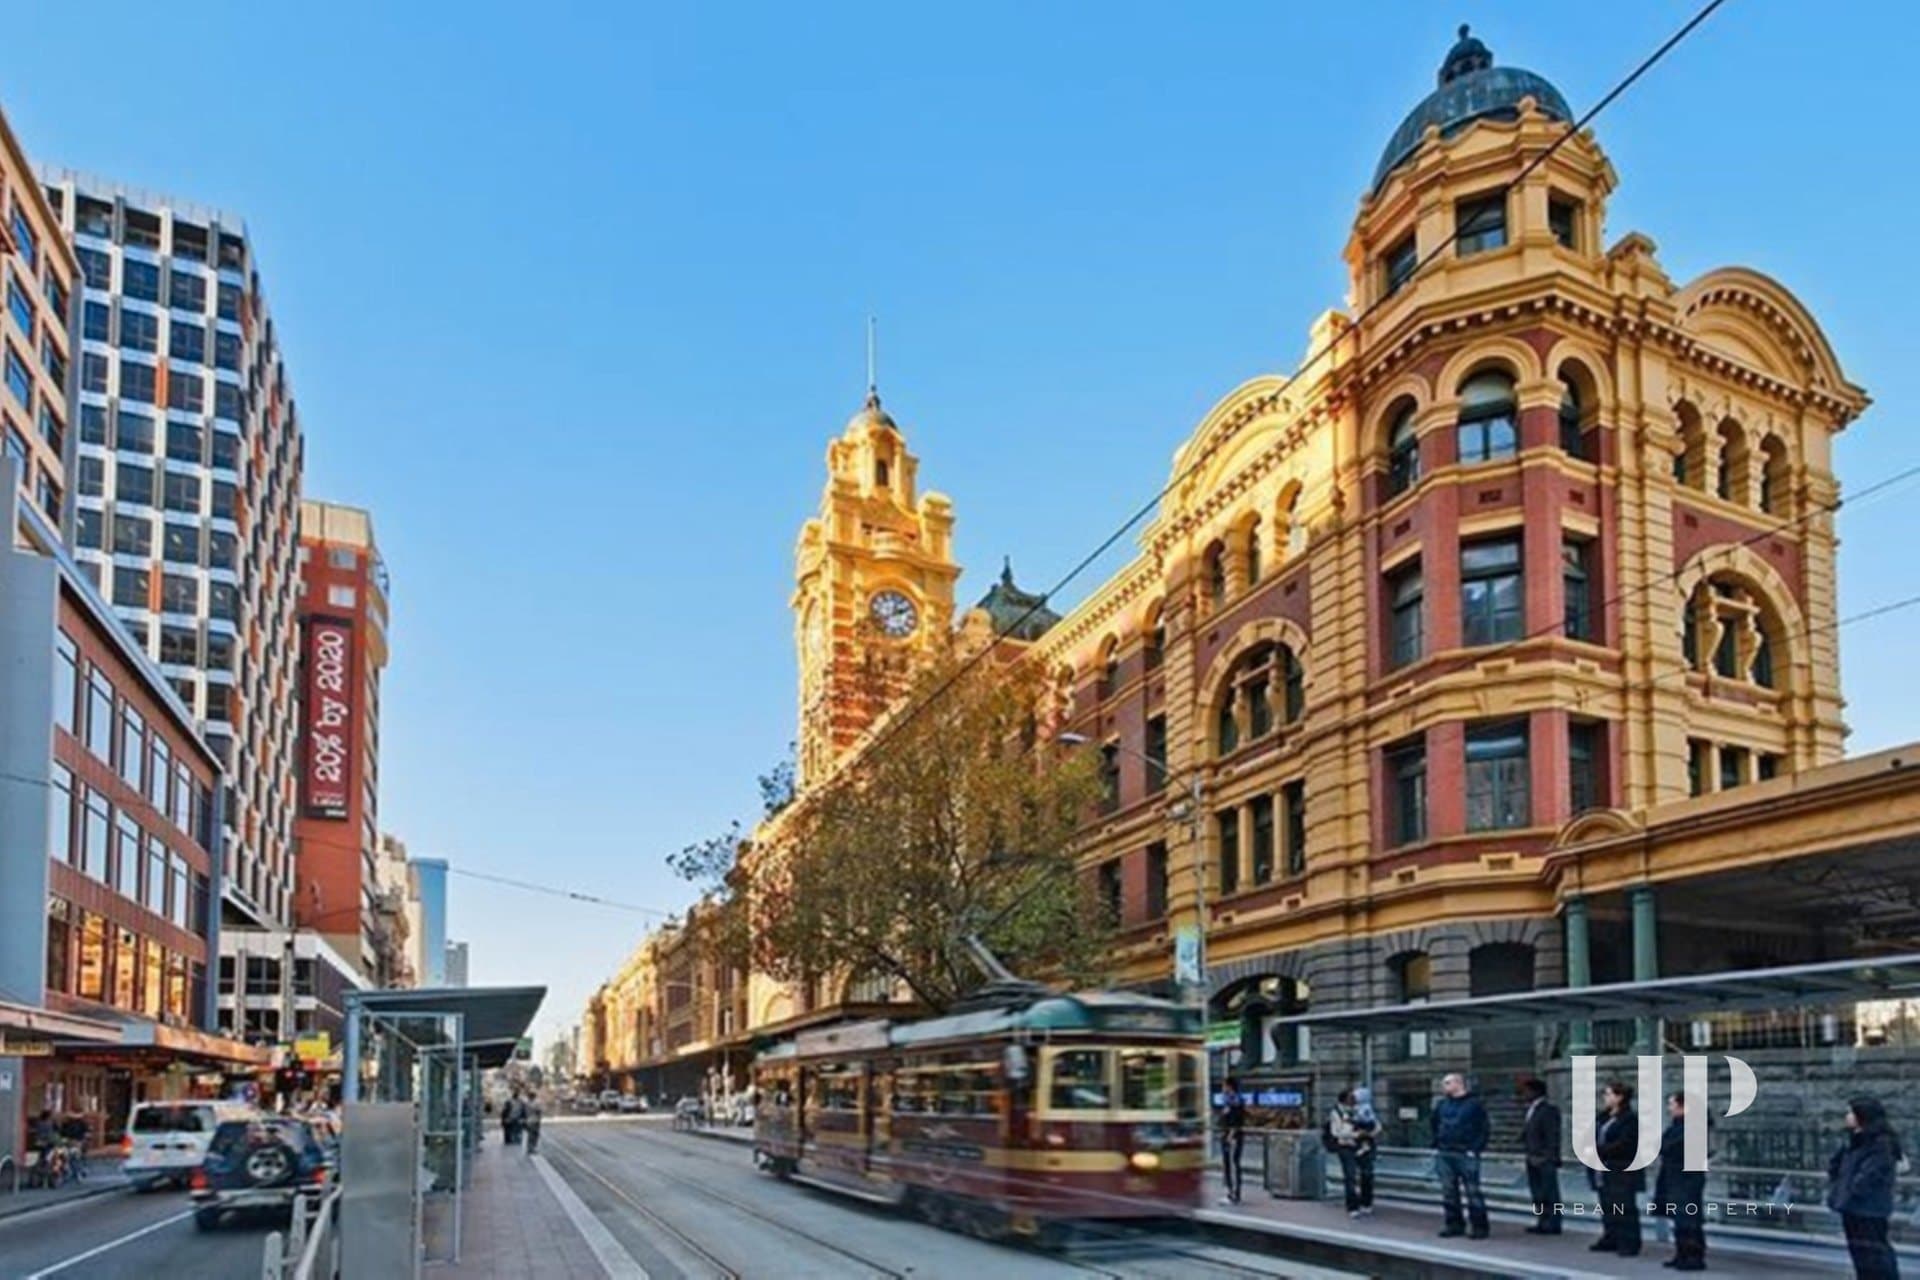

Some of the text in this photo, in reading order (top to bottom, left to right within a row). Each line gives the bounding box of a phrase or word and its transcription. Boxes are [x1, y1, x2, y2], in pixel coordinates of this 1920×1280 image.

[317, 631, 343, 691] 2020
[316, 697, 348, 727] by
[312, 732, 345, 782] 20%
